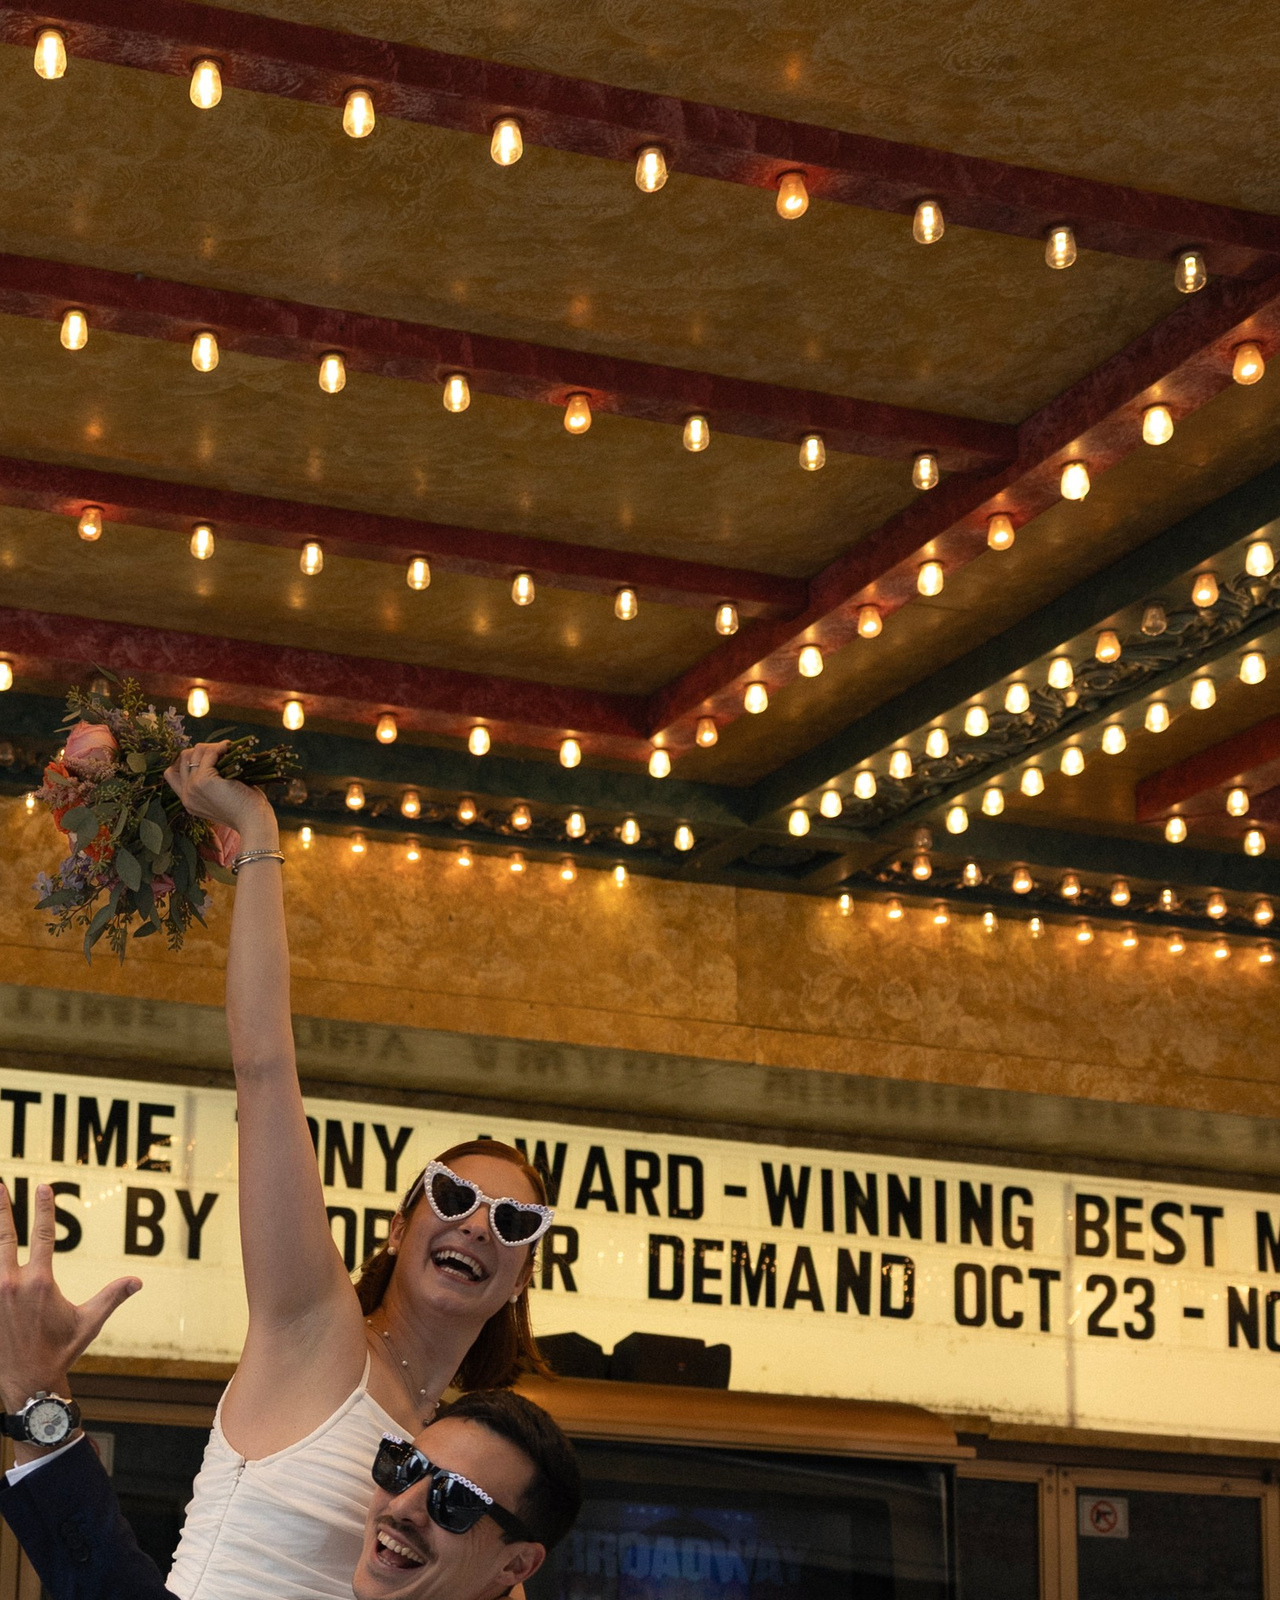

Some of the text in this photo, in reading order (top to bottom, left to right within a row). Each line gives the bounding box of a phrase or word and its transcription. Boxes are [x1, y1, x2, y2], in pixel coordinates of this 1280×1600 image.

[123, 1186, 219, 1261] BY
[648, 1233, 915, 1321] DEMAND
[954, 1262, 1061, 1333] OCT
[1086, 1273, 1155, 1341] 23
[477, 1133, 1034, 1252] WARD-WINNING
[1075, 1192, 1224, 1268] BEST
[453, 1473, 494, 1505] MARRIED
